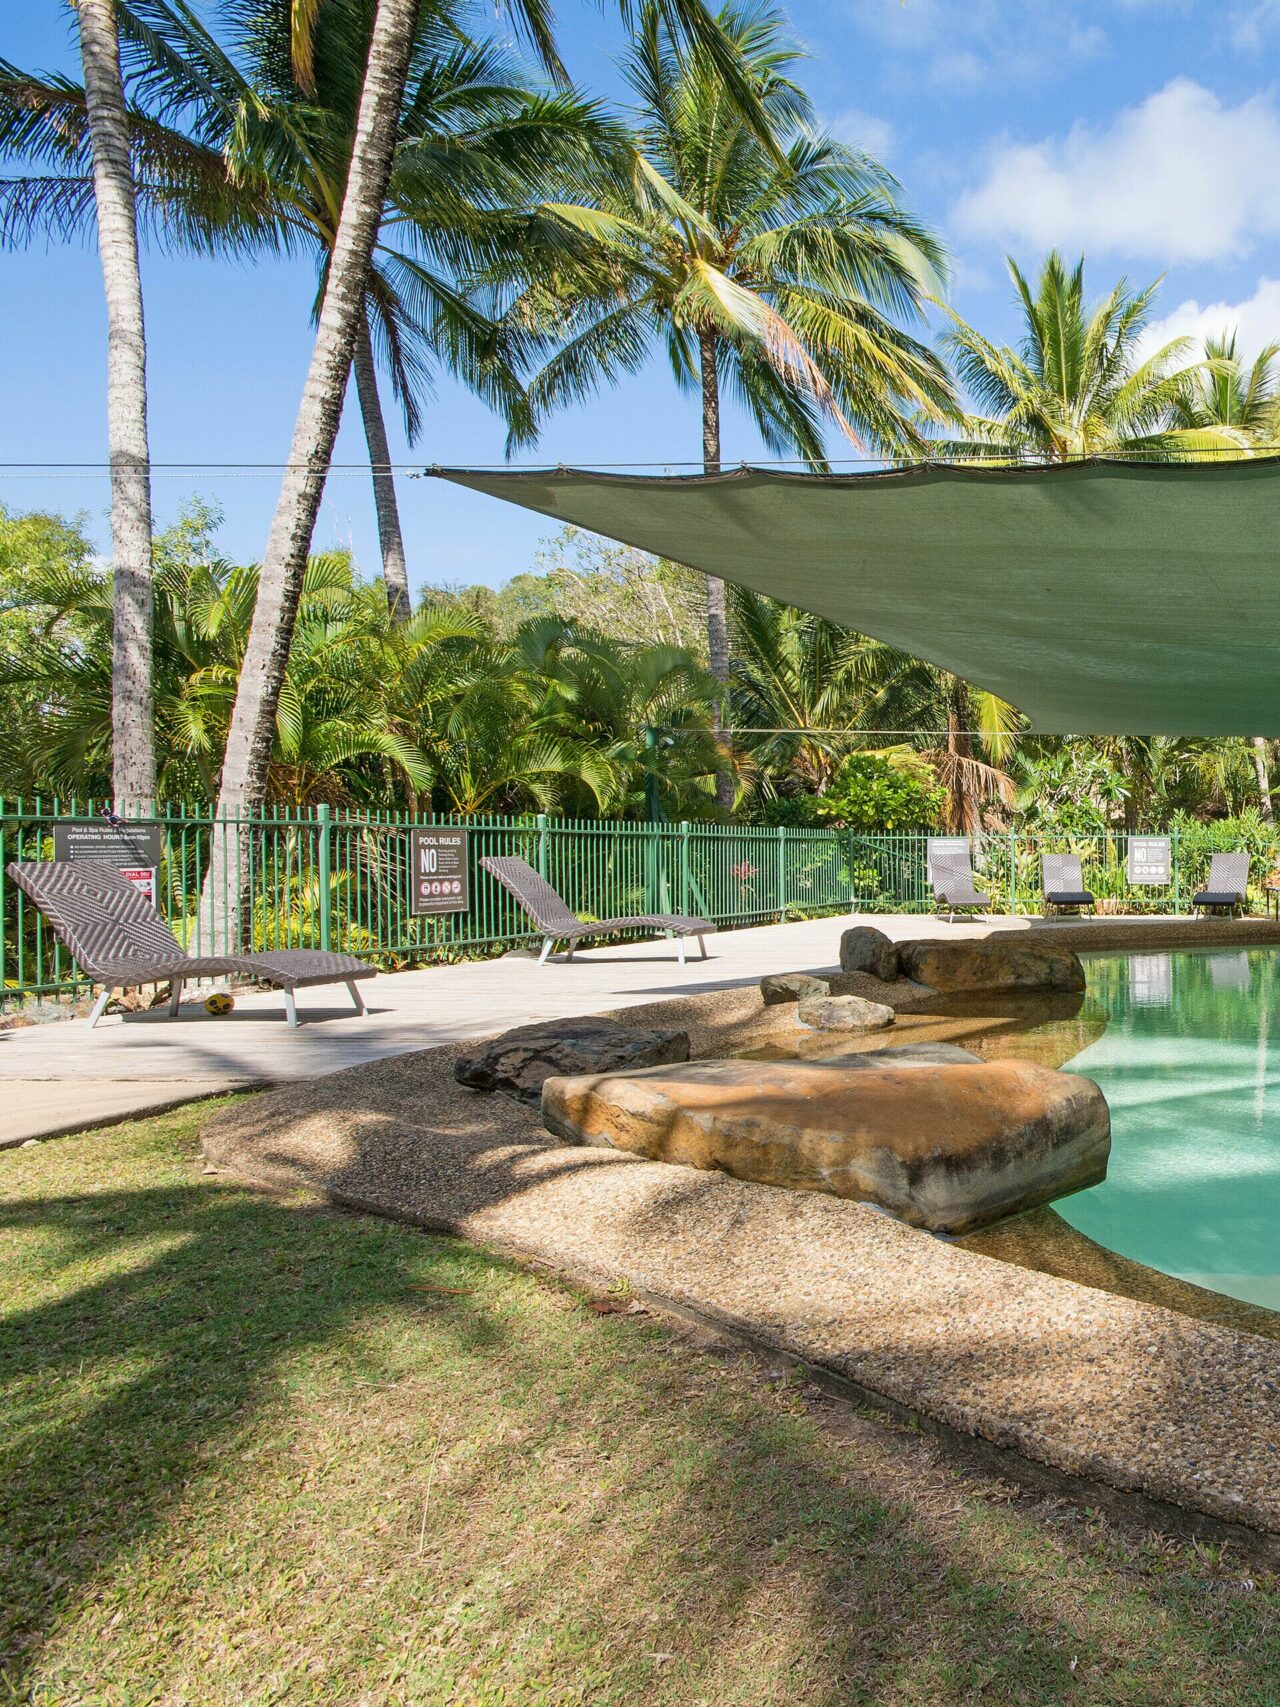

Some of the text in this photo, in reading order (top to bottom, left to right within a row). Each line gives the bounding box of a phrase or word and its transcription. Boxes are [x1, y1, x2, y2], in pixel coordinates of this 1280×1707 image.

[419, 837, 461, 845] POOL RULES
[420, 848, 437, 873] NO
[1134, 847, 1146, 862] NO
